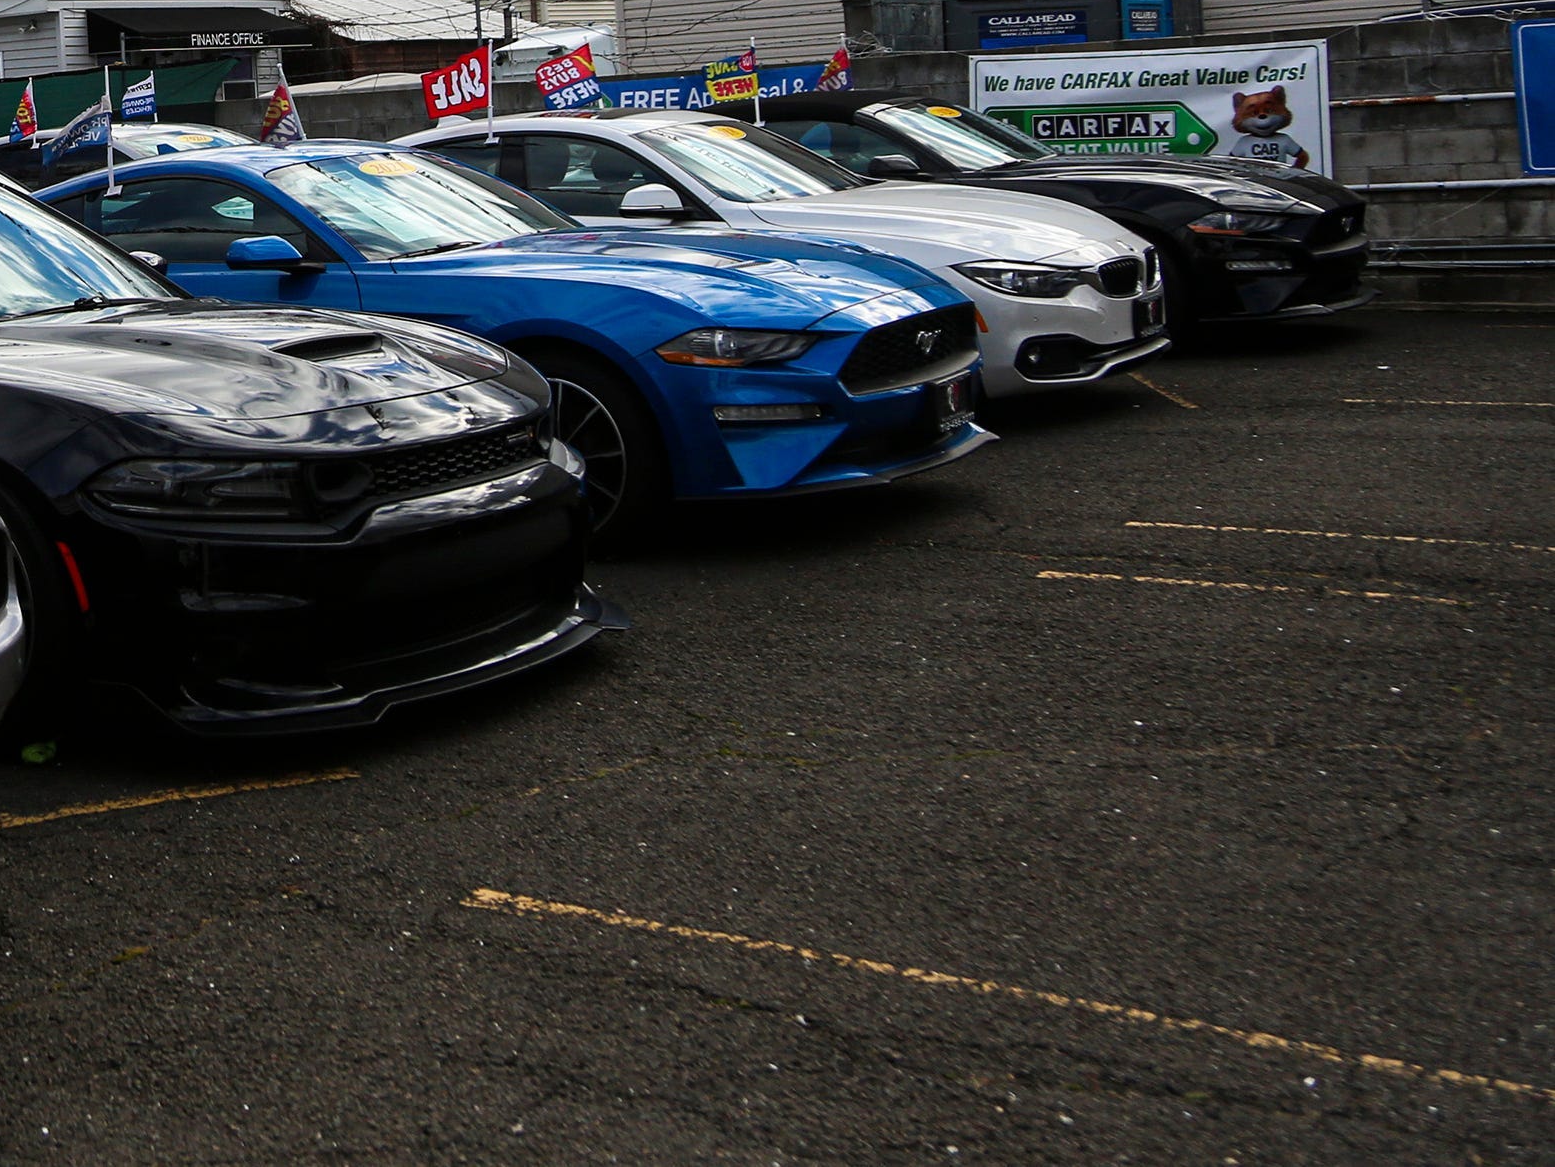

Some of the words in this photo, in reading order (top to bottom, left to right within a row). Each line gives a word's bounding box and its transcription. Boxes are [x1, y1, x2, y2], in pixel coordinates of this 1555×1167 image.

[988, 14, 1076, 25] CALLAHEAD
[191, 33, 231, 46] FINANCE
[232, 32, 264, 45] OFFICE
[985, 75, 1008, 92] We
[1014, 74, 1055, 92] have
[1060, 71, 1133, 91] CARFAX
[1138, 68, 1190, 88] Great
[1196, 65, 1250, 85] Value
[1256, 63, 1308, 83] Cars!
[620, 88, 681, 109] FREE
[1036, 116, 1175, 138] CARFAX
[1106, 141, 1171, 156] VALUE
[1251, 143, 1280, 156] CAR
